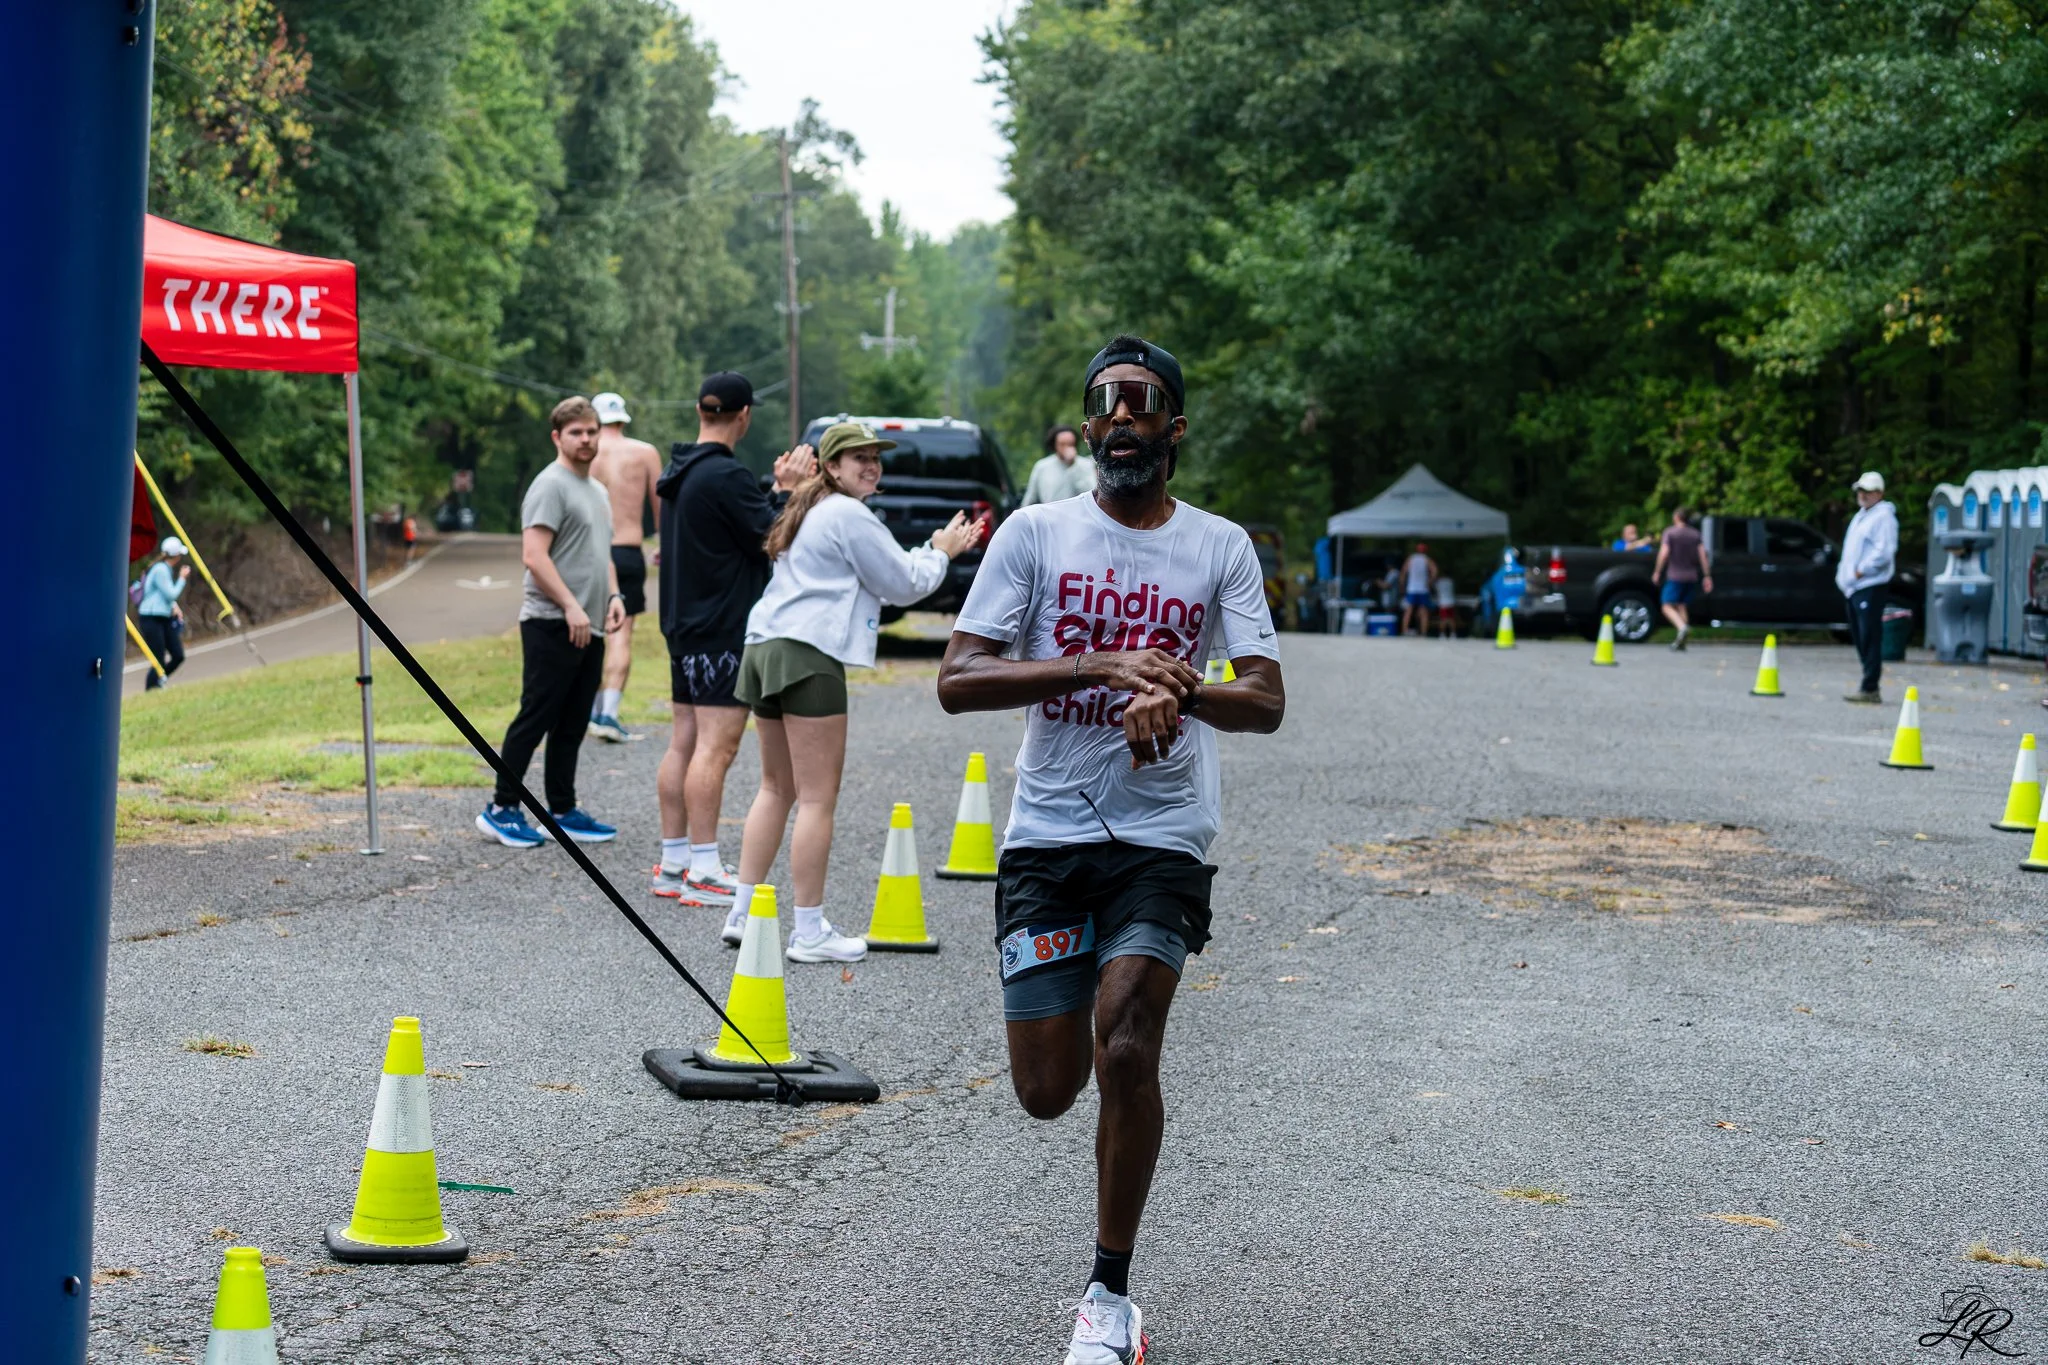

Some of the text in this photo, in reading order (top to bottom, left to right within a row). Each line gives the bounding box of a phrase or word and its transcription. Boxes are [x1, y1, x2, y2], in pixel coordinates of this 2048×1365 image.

[161, 278, 322, 340] THERE
[1058, 572, 1205, 639] Finding
[1033, 926, 1085, 961] 897
